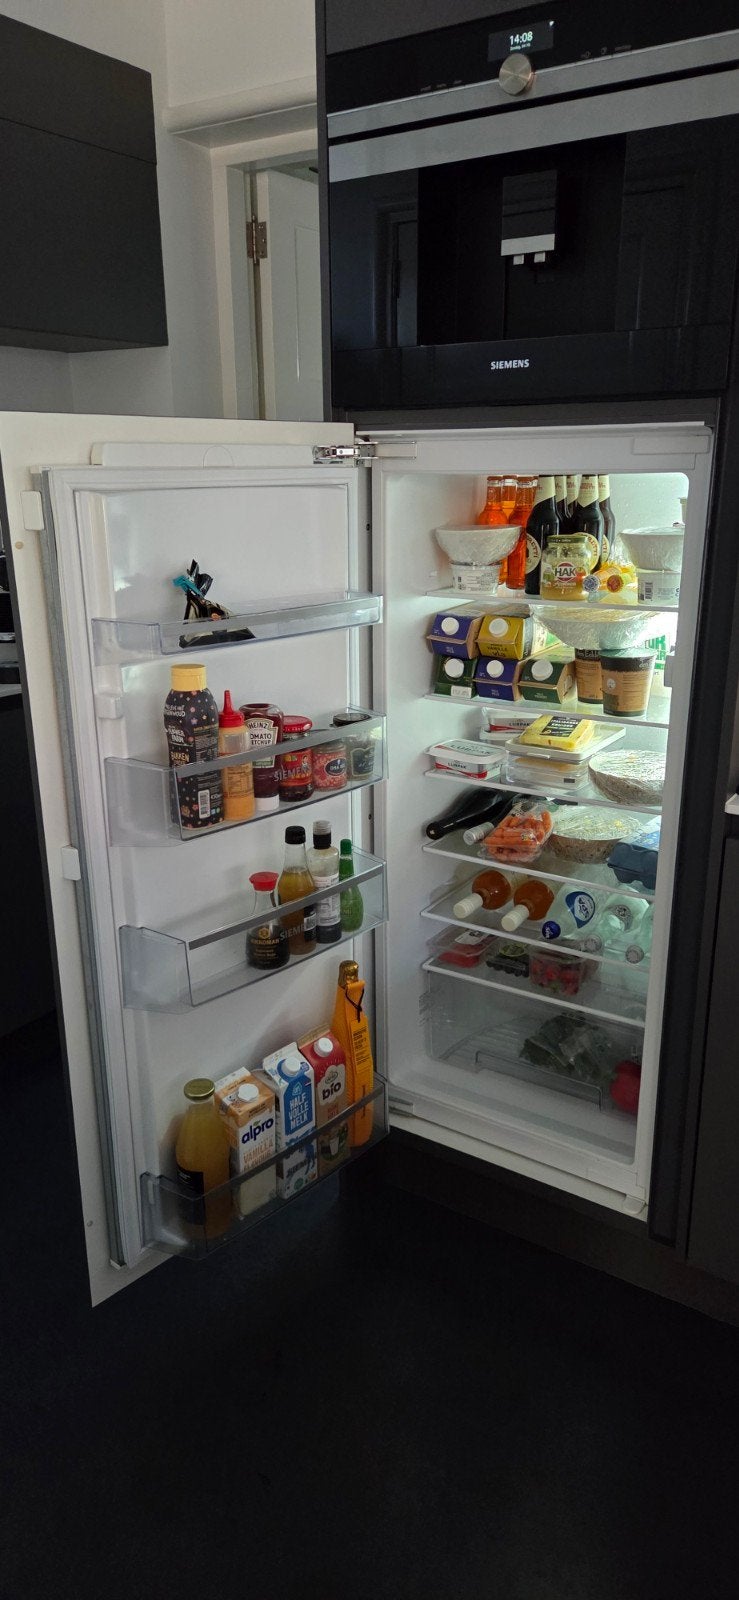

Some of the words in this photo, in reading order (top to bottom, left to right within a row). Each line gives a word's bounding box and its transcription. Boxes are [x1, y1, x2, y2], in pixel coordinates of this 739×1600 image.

[510, 31, 533, 46] 14:08
[490, 358, 530, 370] SIEMENS
[554, 567, 576, 577] HAK
[248, 722, 268, 730] HEINZ
[274, 764, 310, 782] SIEMEN
[288, 1100, 309, 1120] VOLLE
[289, 1092, 307, 1110] HALF
[290, 1110, 309, 1131] MELK
[242, 1118, 274, 1144] alpro
